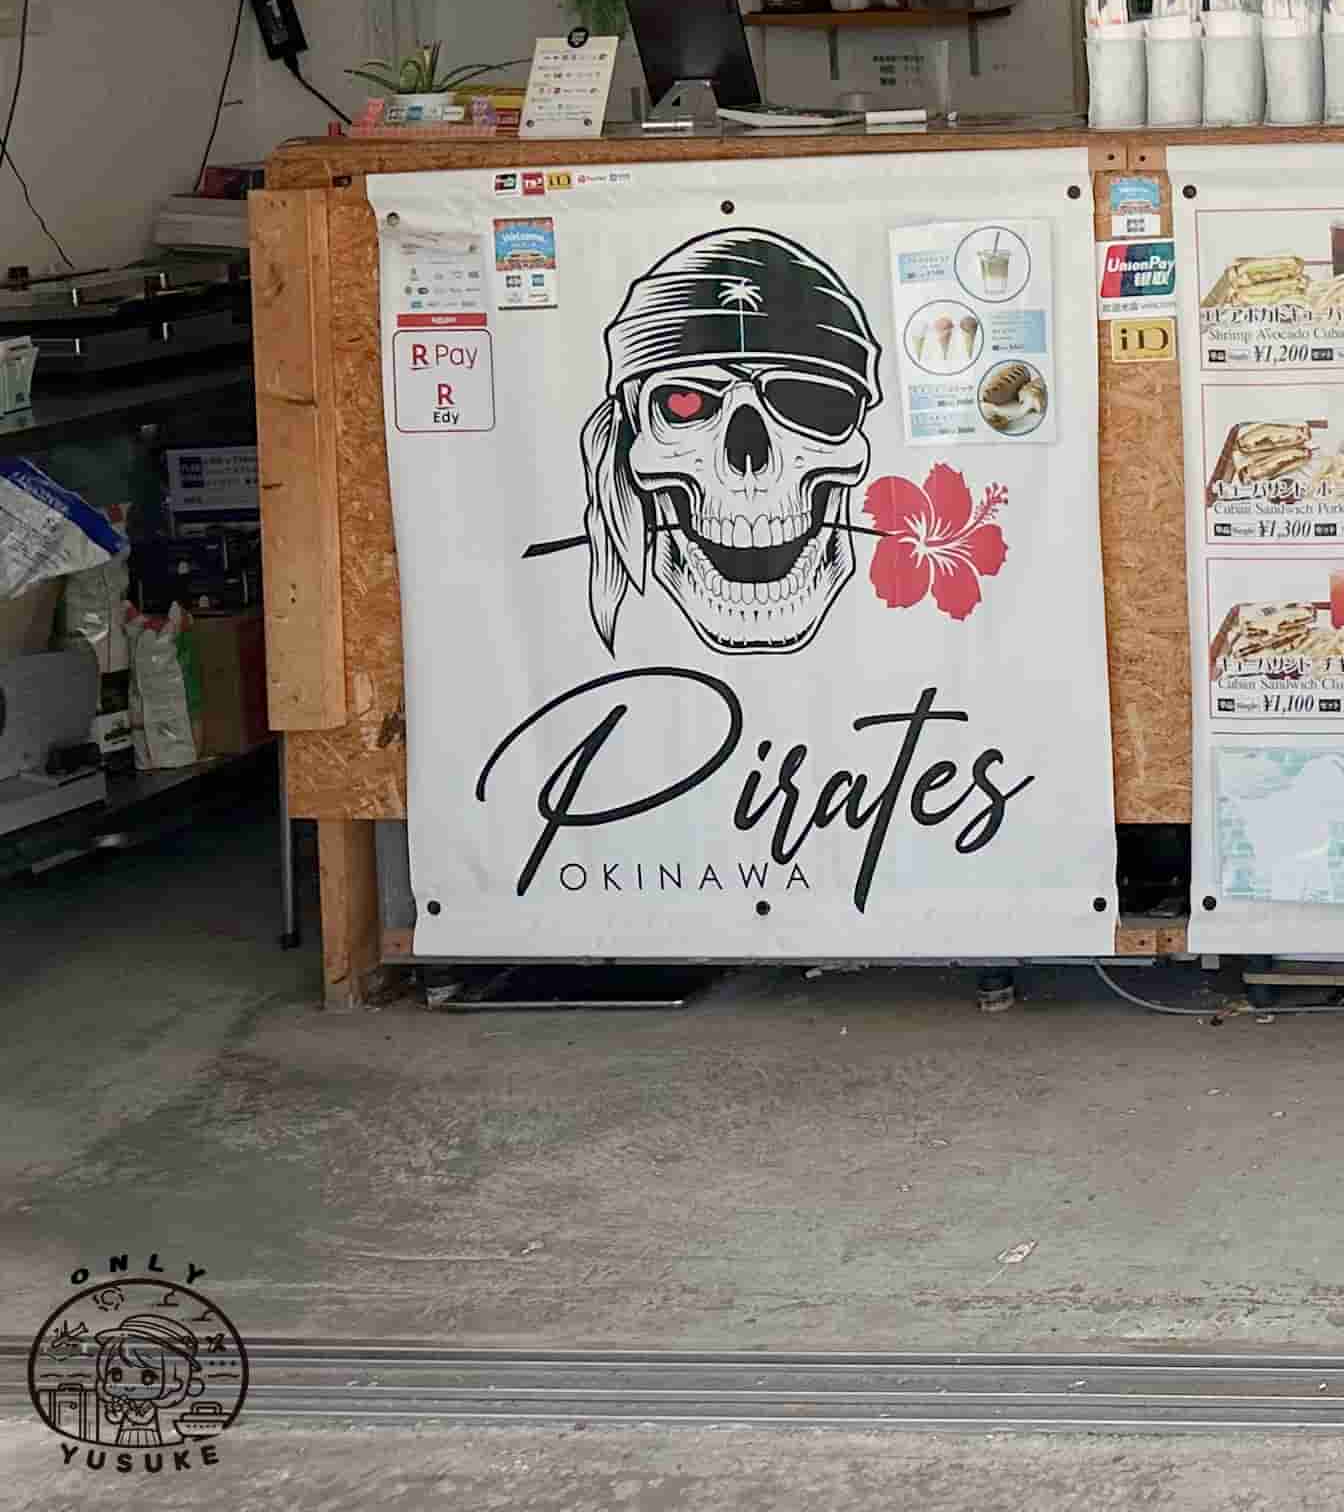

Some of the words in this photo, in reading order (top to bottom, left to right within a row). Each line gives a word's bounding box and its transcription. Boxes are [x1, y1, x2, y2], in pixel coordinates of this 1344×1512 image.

[1107, 255, 1176, 274] UnionPay
[1120, 327, 1169, 350] iD
[435, 344, 478, 370] Pay
[1254, 344, 1309, 366] ¥1,200
[433, 410, 460, 425] Edy
[1258, 520, 1312, 538] ¥1,300
[1264, 695, 1314, 713] ¥1,100
[476, 666, 1035, 914] Pirates
[559, 863, 809, 891] OKINAWA
